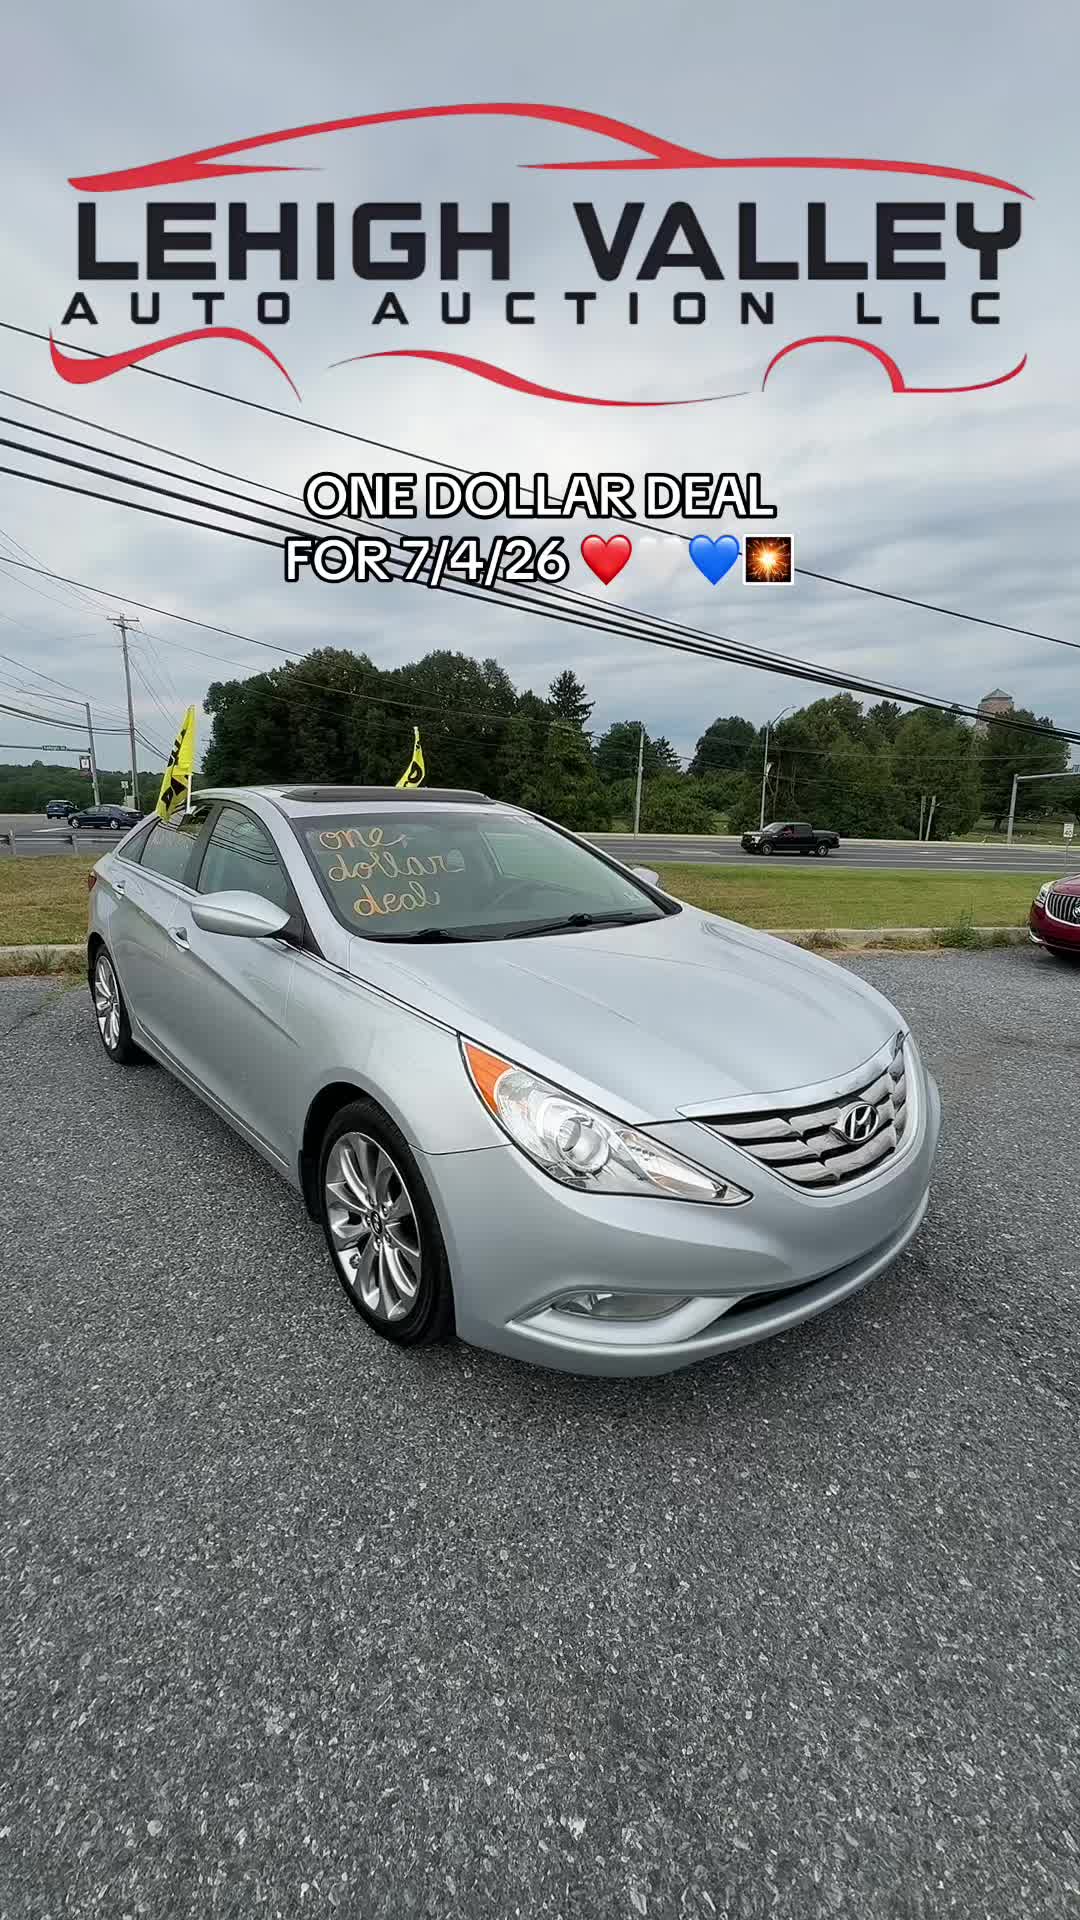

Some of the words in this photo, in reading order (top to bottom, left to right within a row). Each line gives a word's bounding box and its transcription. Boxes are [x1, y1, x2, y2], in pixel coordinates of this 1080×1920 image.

[319, 828, 406, 850] one
[328, 851, 465, 882] dollar
[353, 881, 440, 916] deal
